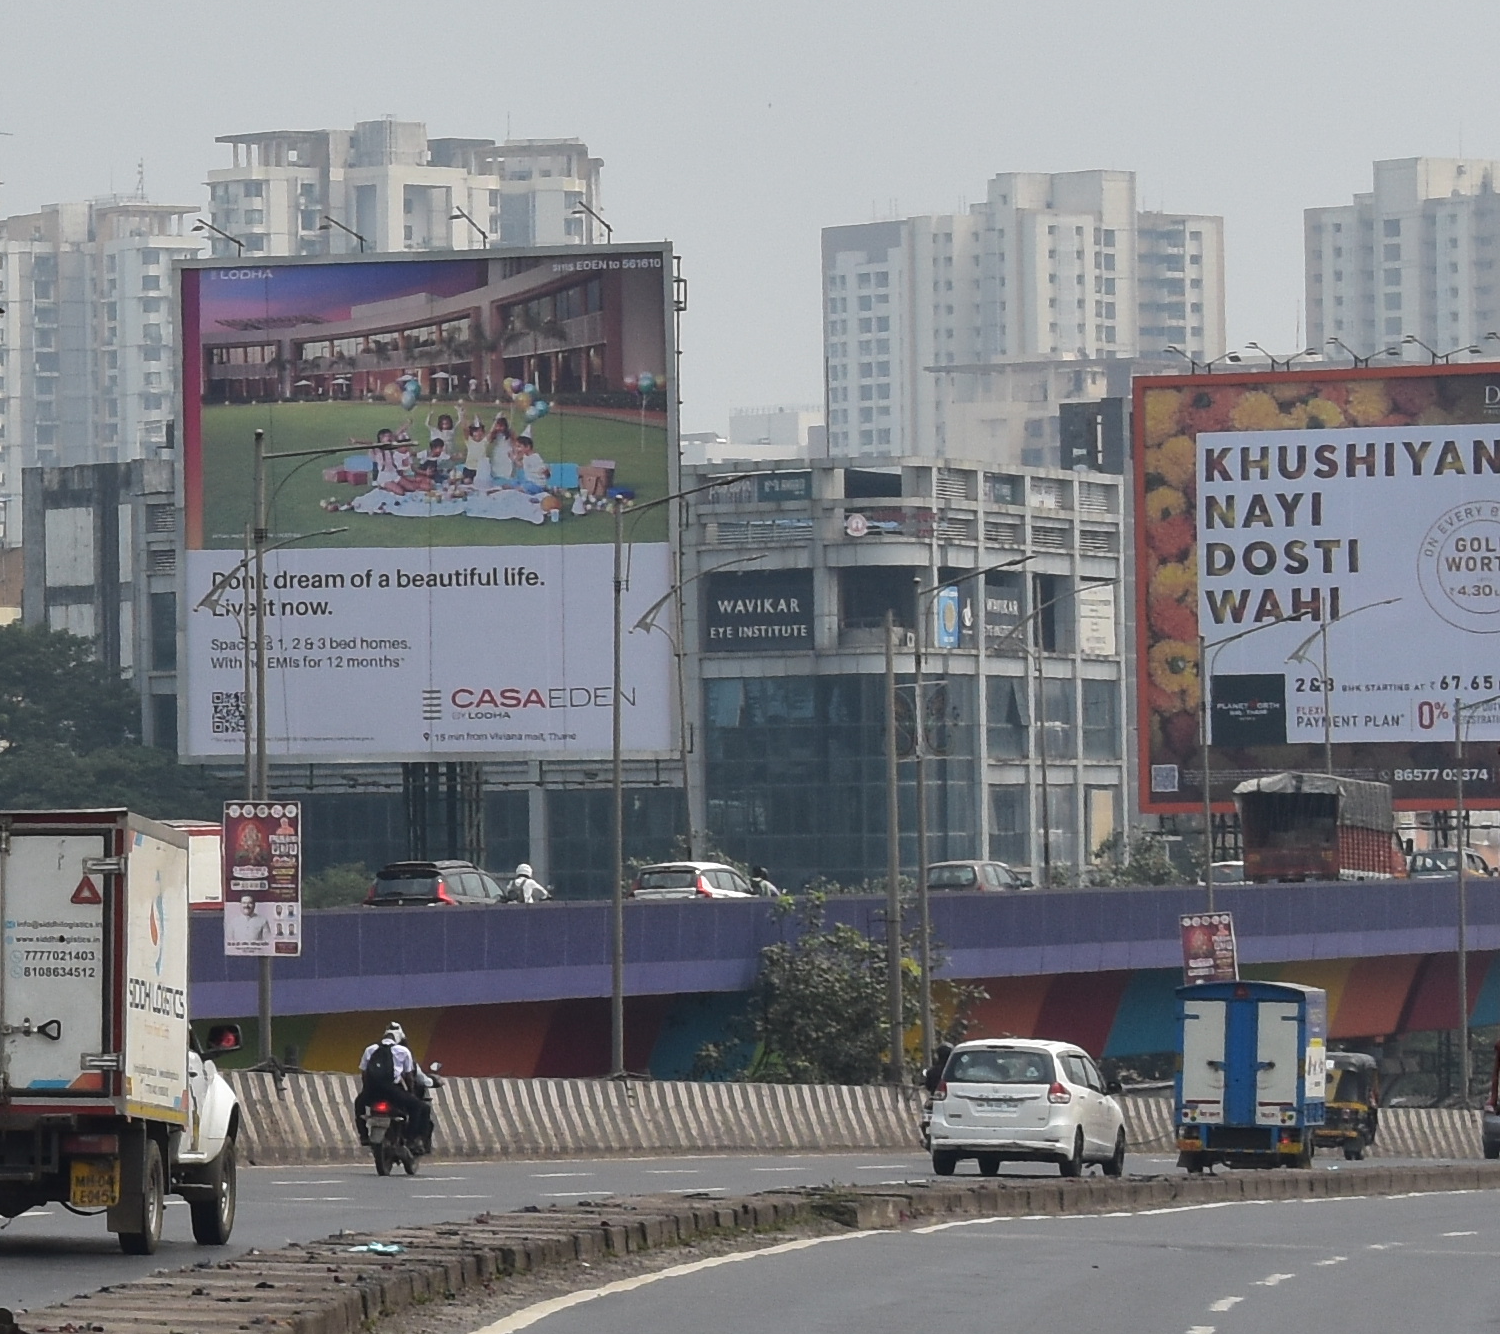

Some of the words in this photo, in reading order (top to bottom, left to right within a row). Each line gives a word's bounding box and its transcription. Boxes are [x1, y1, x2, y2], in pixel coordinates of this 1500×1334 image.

[576, 259, 607, 271] EDEN
[609, 260, 620, 269] to
[220, 269, 273, 279] LODHA
[1205, 492, 1323, 530] NAYI
[1424, 537, 1439, 558] ON
[1437, 506, 1482, 535] EVERY
[1205, 539, 1359, 577] DOSTI
[274, 571, 345, 589] dream
[350, 569, 373, 588] of
[378, 573, 390, 588] a
[397, 567, 499, 588] beautiful
[504, 566, 546, 587] life.
[263, 598, 276, 617] it
[281, 599, 333, 617] now.
[717, 598, 800, 614] WAVIKAR
[1205, 586, 1340, 625] WAHI
[710, 626, 733, 639] EYE
[738, 624, 808, 638] INSTITUTE
[277, 638, 288, 652] 1,
[292, 639, 301, 650] 2
[304, 638, 315, 650] &
[317, 638, 326, 650] 3
[330, 637, 357, 650] bed
[360, 637, 412, 650] homes.
[210, 656, 243, 669] With
[267, 656, 300, 669] EMIs
[302, 656, 323, 668] for
[326, 656, 343, 668] 12
[1365, 683, 1410, 692] STARTING
[1413, 683, 1426, 691] AT
[468, 711, 511, 720] LODHA
[1418, 701, 1449, 730] 0%
[447, 733, 465, 742] min
[466, 732, 488, 741] from
[1394, 768, 1440, 781] 86577
[24, 950, 96, 961] 7777021403
[23, 966, 96, 978] 8108634512
